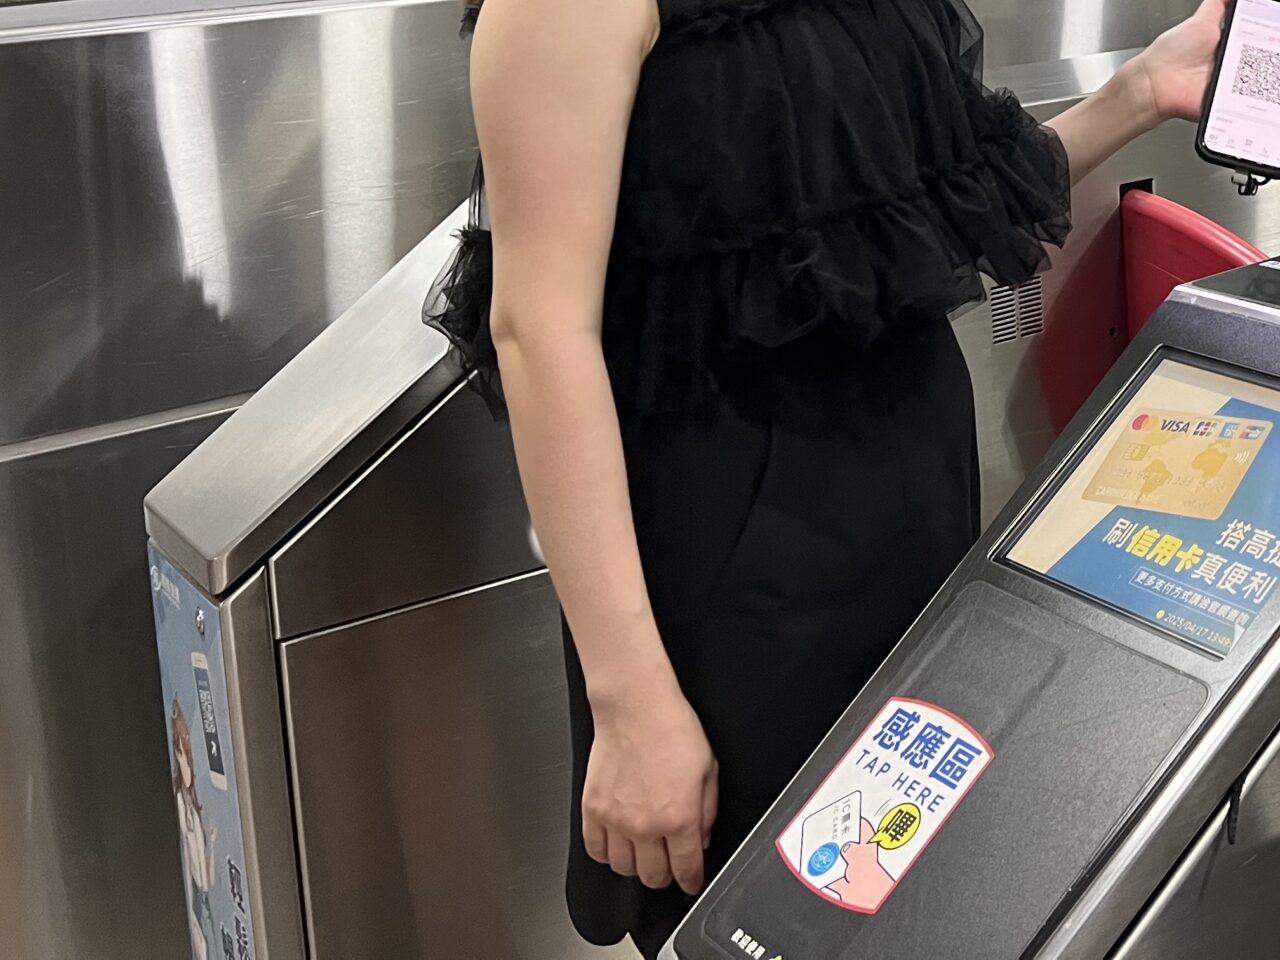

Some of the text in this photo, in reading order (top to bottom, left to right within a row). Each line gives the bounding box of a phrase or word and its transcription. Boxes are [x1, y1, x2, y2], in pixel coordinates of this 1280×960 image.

[1160, 419, 1190, 433] VISA
[1102, 518, 1277, 604] 刷信用卡真便利
[1164, 612, 1209, 638] 2025/04/17
[856, 749, 944, 813] TAP HERE
[873, 708, 982, 790] 感應區
